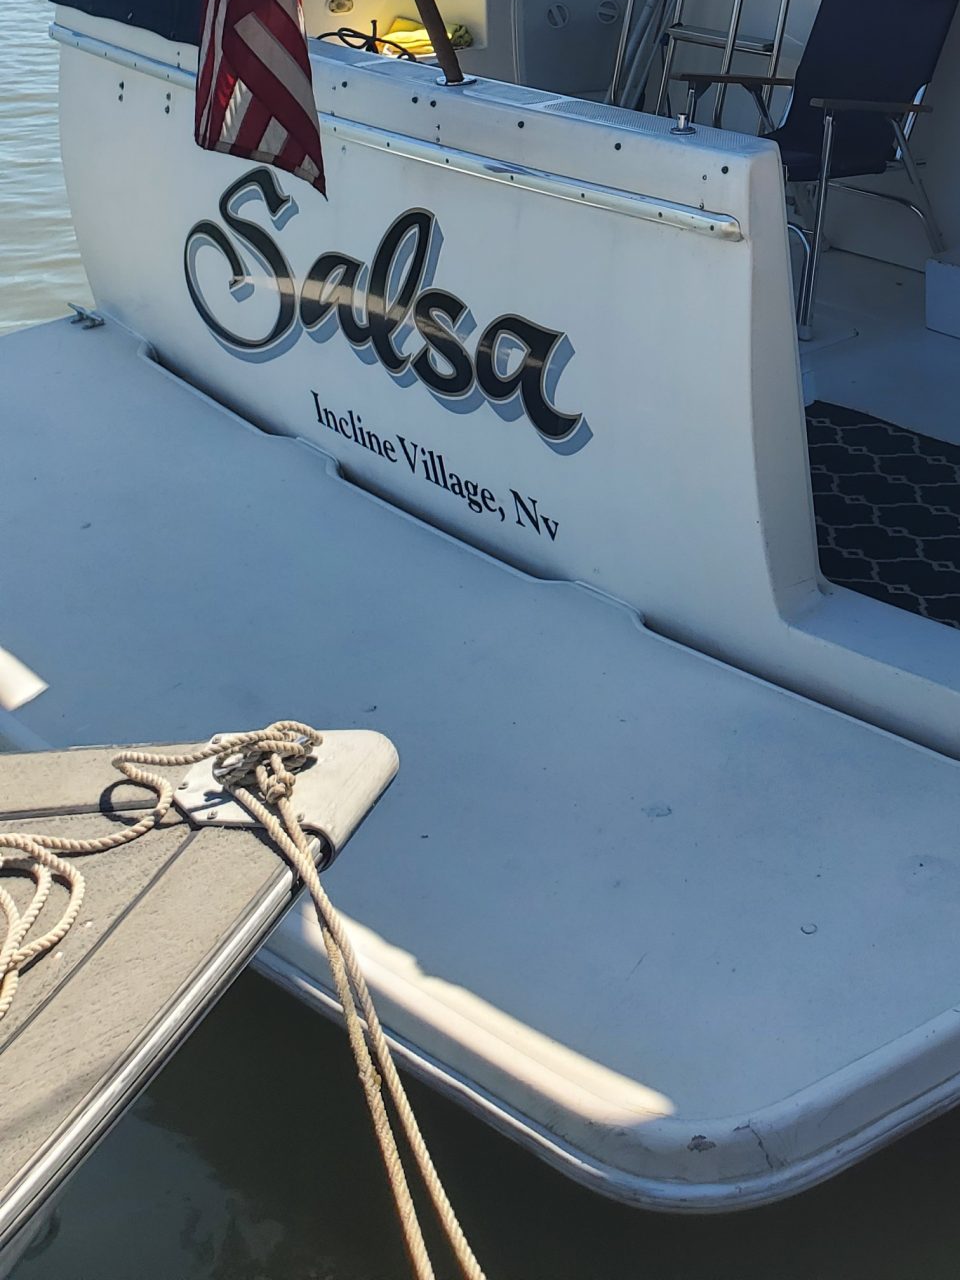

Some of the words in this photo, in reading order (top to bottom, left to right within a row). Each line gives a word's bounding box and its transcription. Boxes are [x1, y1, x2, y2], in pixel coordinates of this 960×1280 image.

[184, 166, 593, 455] Salsa
[311, 390, 397, 463] Incline
[396, 434, 505, 522] Village,
